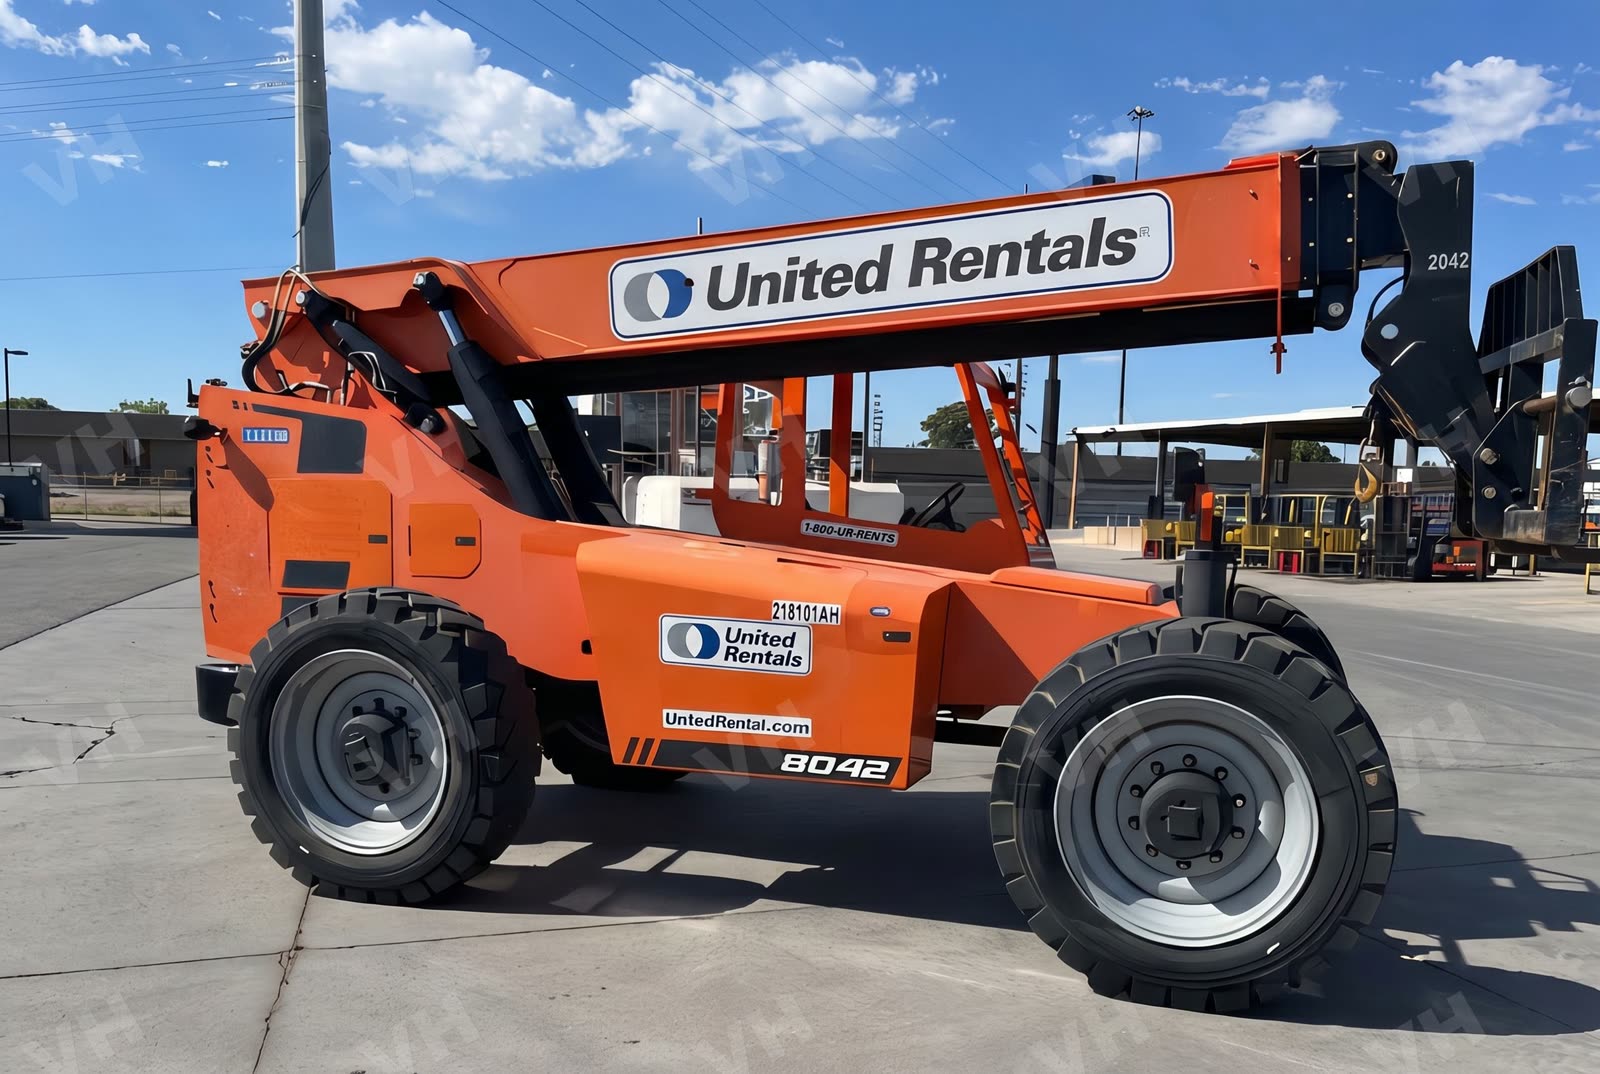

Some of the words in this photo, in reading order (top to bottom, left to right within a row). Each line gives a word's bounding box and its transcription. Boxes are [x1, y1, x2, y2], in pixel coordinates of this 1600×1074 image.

[1428, 252, 1469, 270] 2042
[707, 243, 894, 311] United
[804, 522, 896, 543] 1-800-UR-RENTS
[772, 602, 839, 624] 218101AH
[725, 627, 797, 648] United
[724, 646, 803, 667] Rentals
[665, 712, 809, 734] UntedRental.com
[780, 753, 890, 780] 8042
